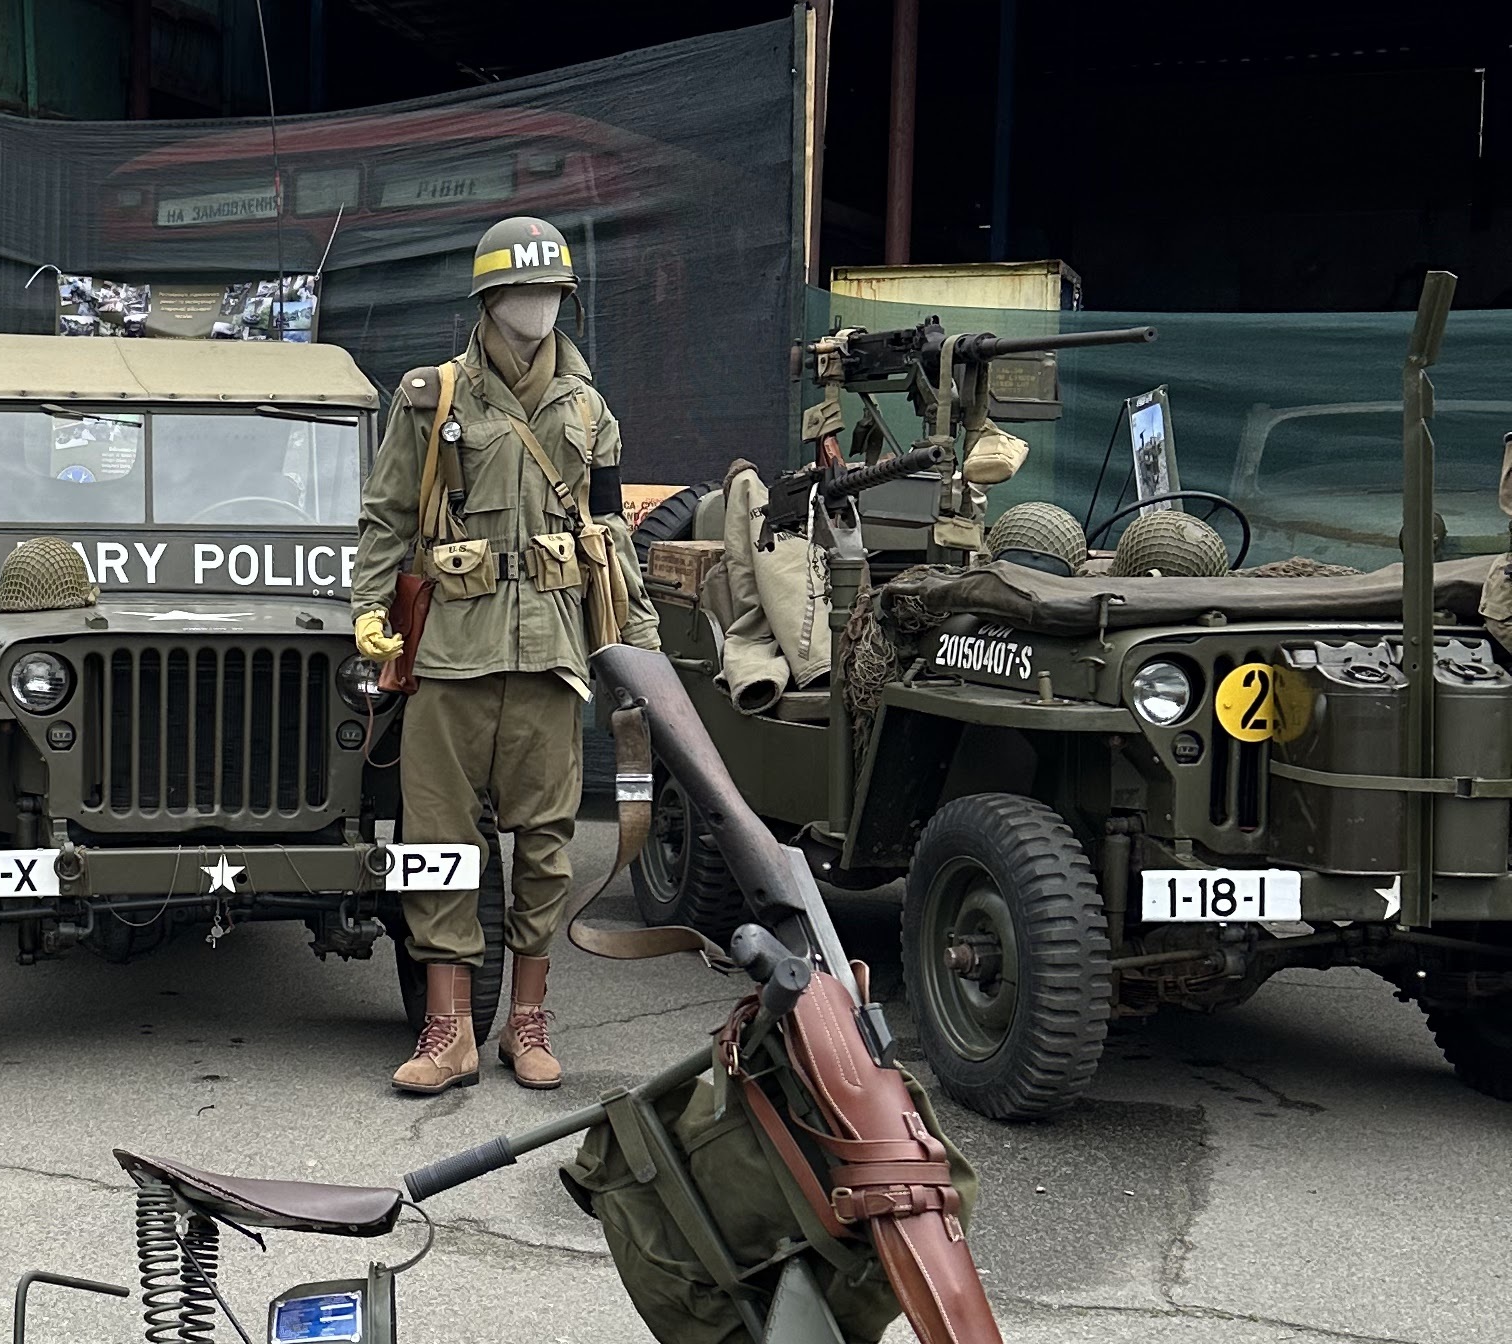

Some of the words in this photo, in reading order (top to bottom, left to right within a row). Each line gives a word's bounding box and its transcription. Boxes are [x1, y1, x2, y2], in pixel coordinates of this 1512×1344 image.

[513, 241, 560, 268] MP
[935, 633, 1033, 679] 20150407-S
[1241, 670, 1269, 730] 2
[402, 853, 462, 886] P-7
